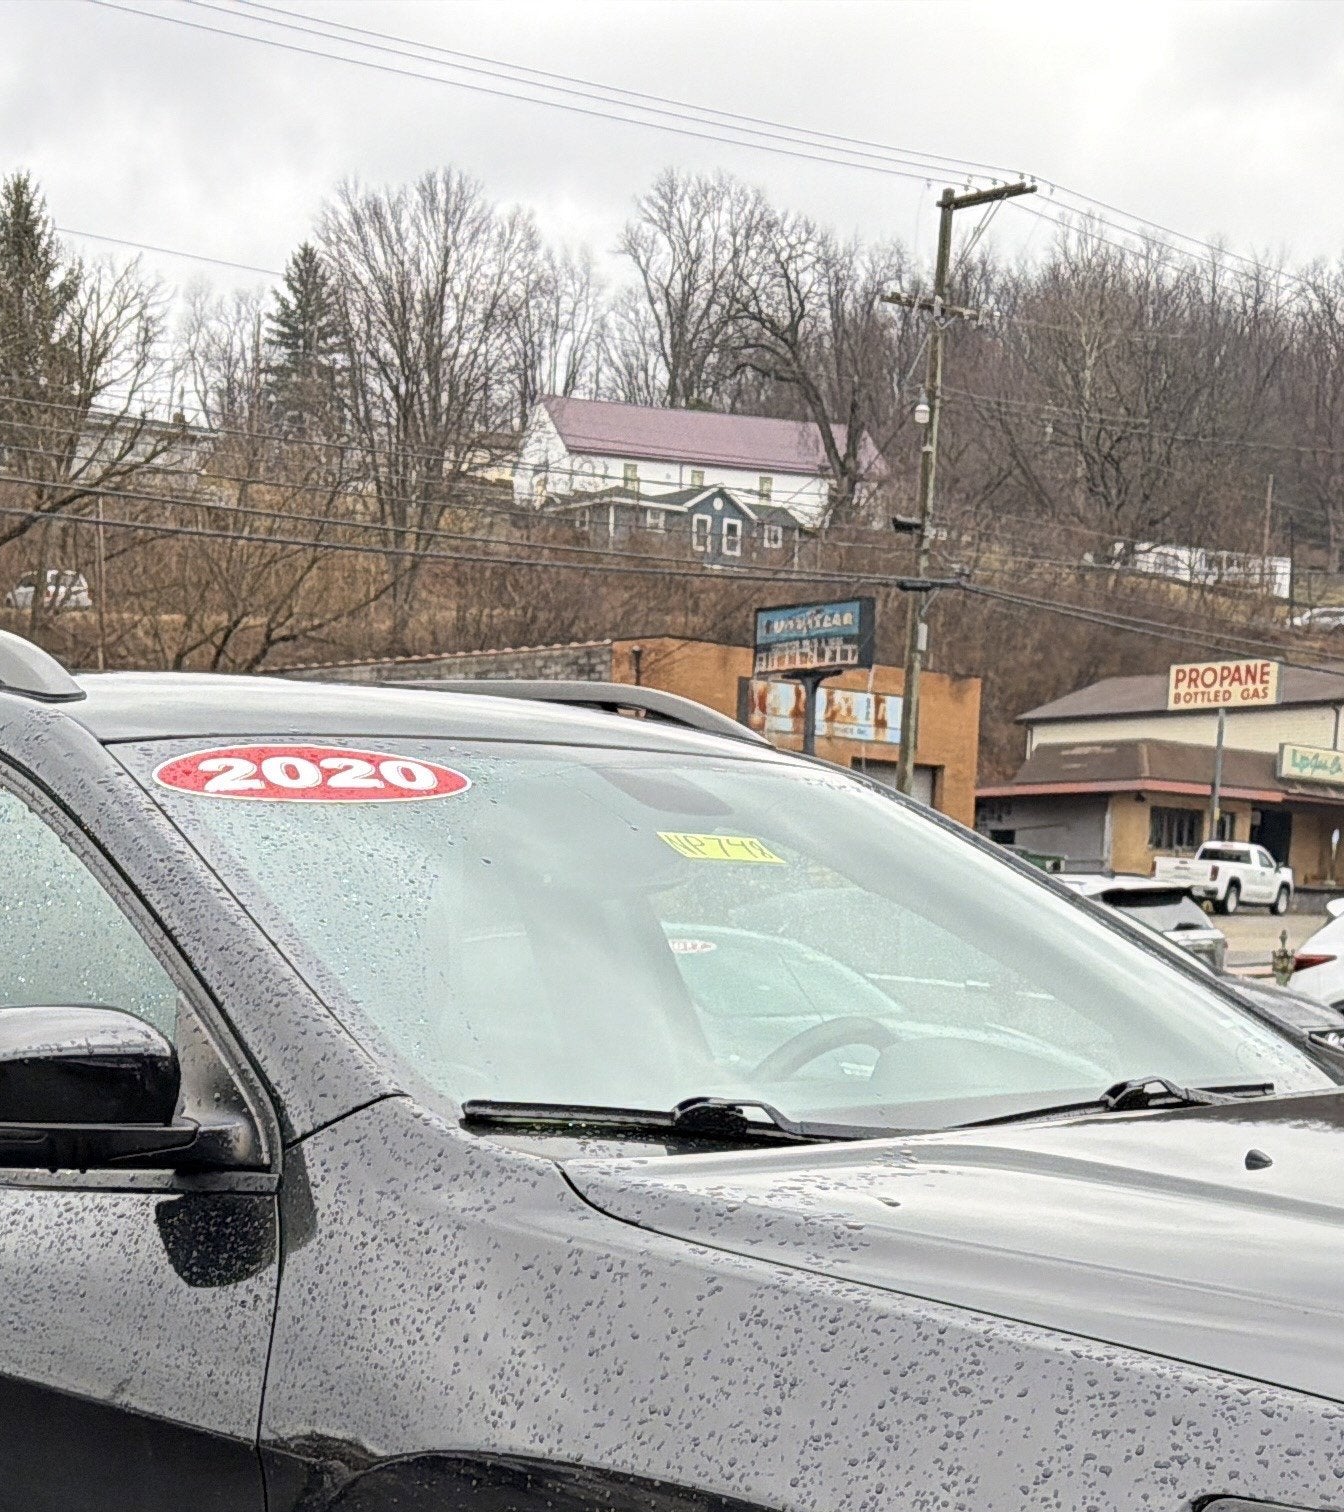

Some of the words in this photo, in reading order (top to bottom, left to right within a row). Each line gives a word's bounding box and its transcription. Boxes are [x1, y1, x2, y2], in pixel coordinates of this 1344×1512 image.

[1174, 662, 1271, 690] PROPANE
[1173, 690, 1232, 704] BOTTLED
[1240, 687, 1268, 701] GAS
[199, 753, 439, 792] 2020
